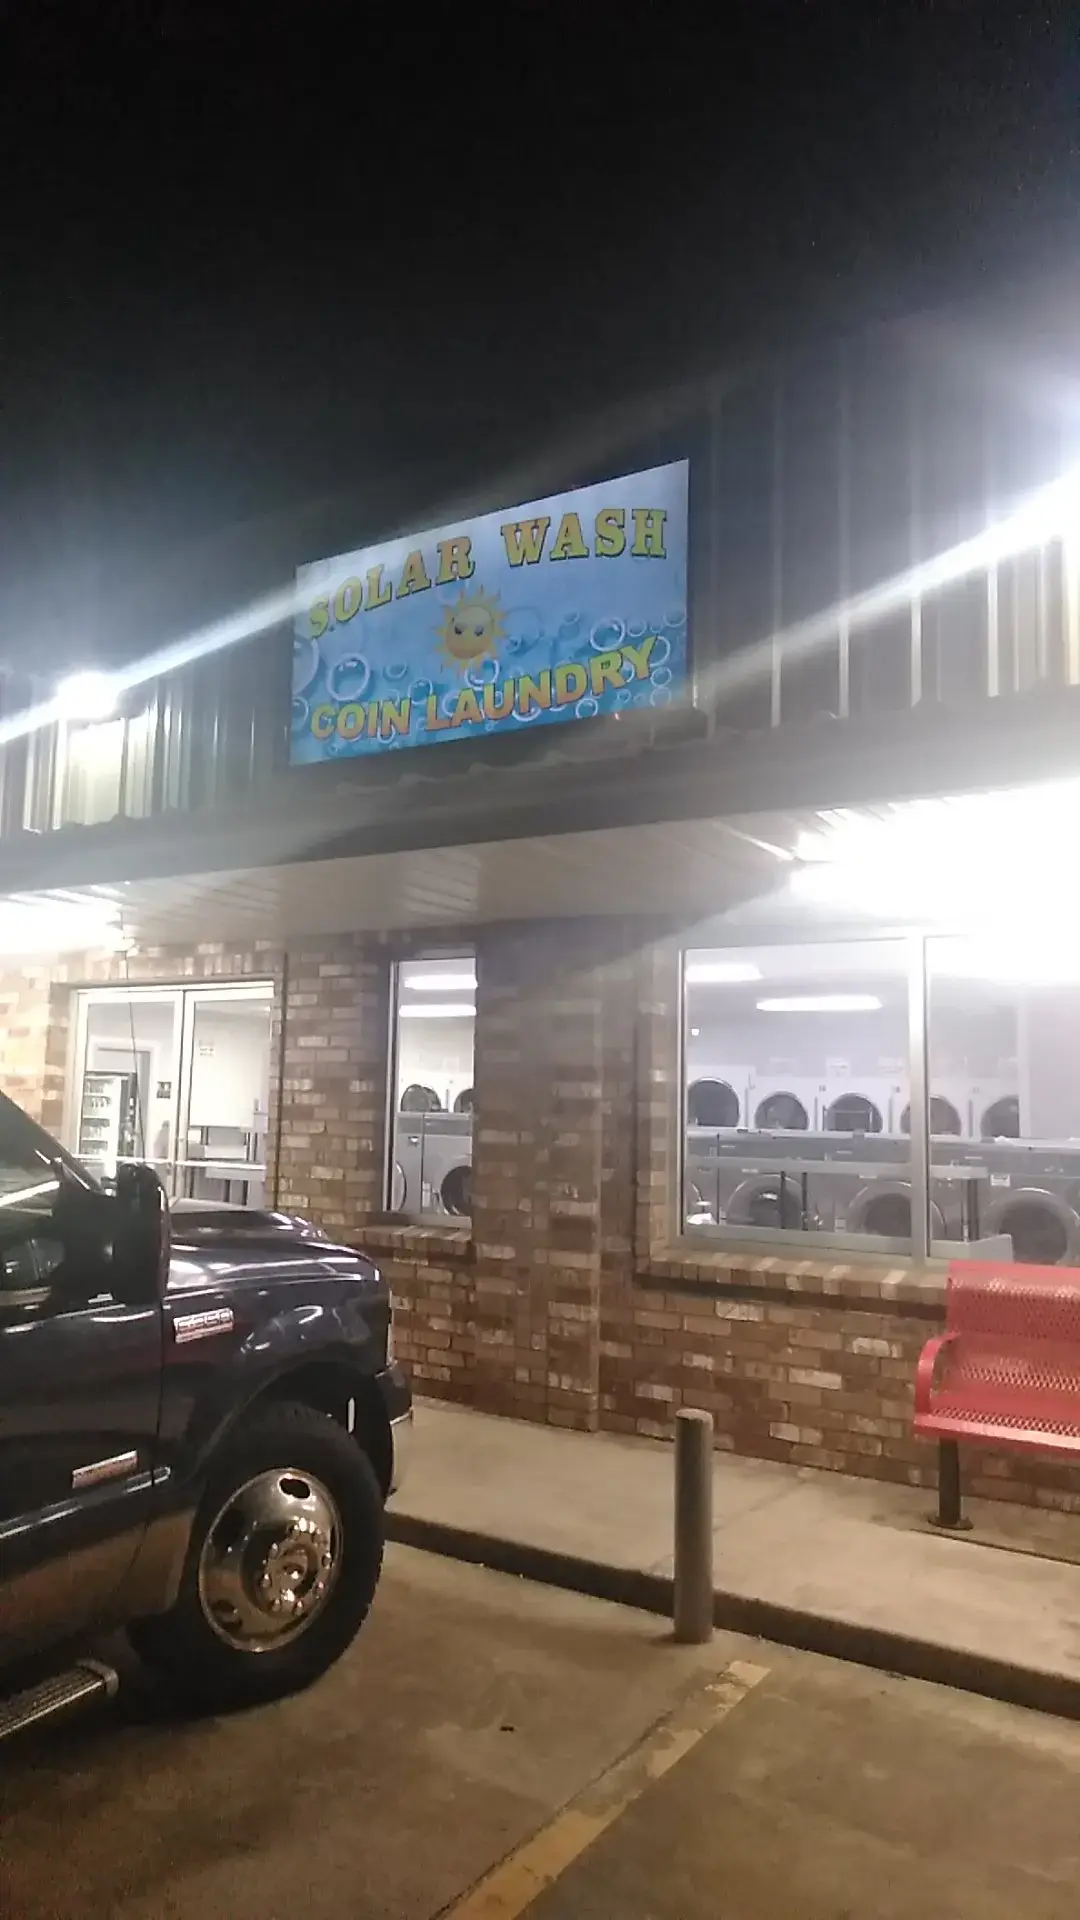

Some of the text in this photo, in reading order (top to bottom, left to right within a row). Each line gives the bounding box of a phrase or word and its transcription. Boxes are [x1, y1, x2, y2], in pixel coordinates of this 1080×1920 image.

[309, 508, 667, 638] SOLAR WASH
[311, 635, 658, 740] COIN LAUNDRY
